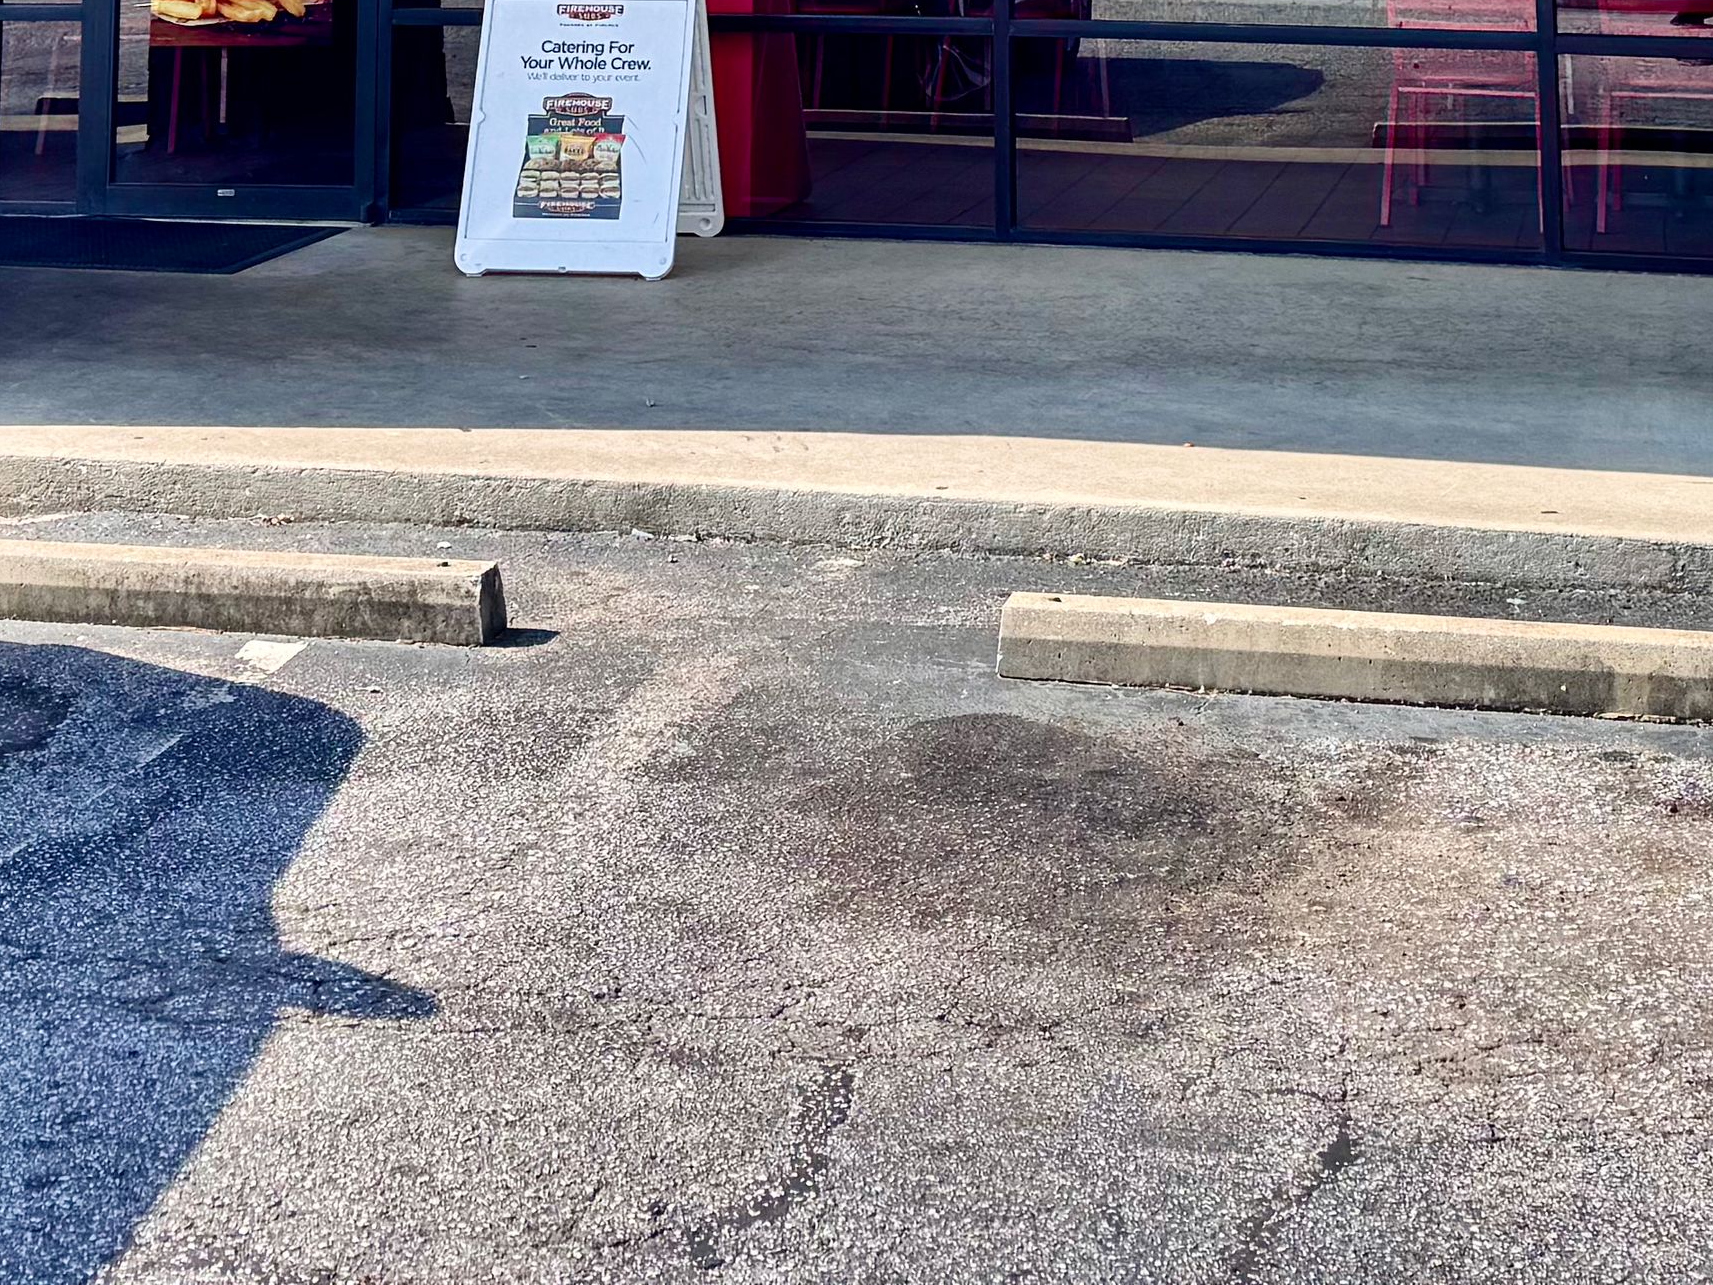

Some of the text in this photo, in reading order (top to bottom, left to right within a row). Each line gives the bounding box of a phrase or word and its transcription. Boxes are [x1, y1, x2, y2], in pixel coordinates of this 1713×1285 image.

[541, 40, 635, 56] Catering For
[521, 55, 652, 70] Your Whole Crew.
[550, 118, 602, 126] Great Food
